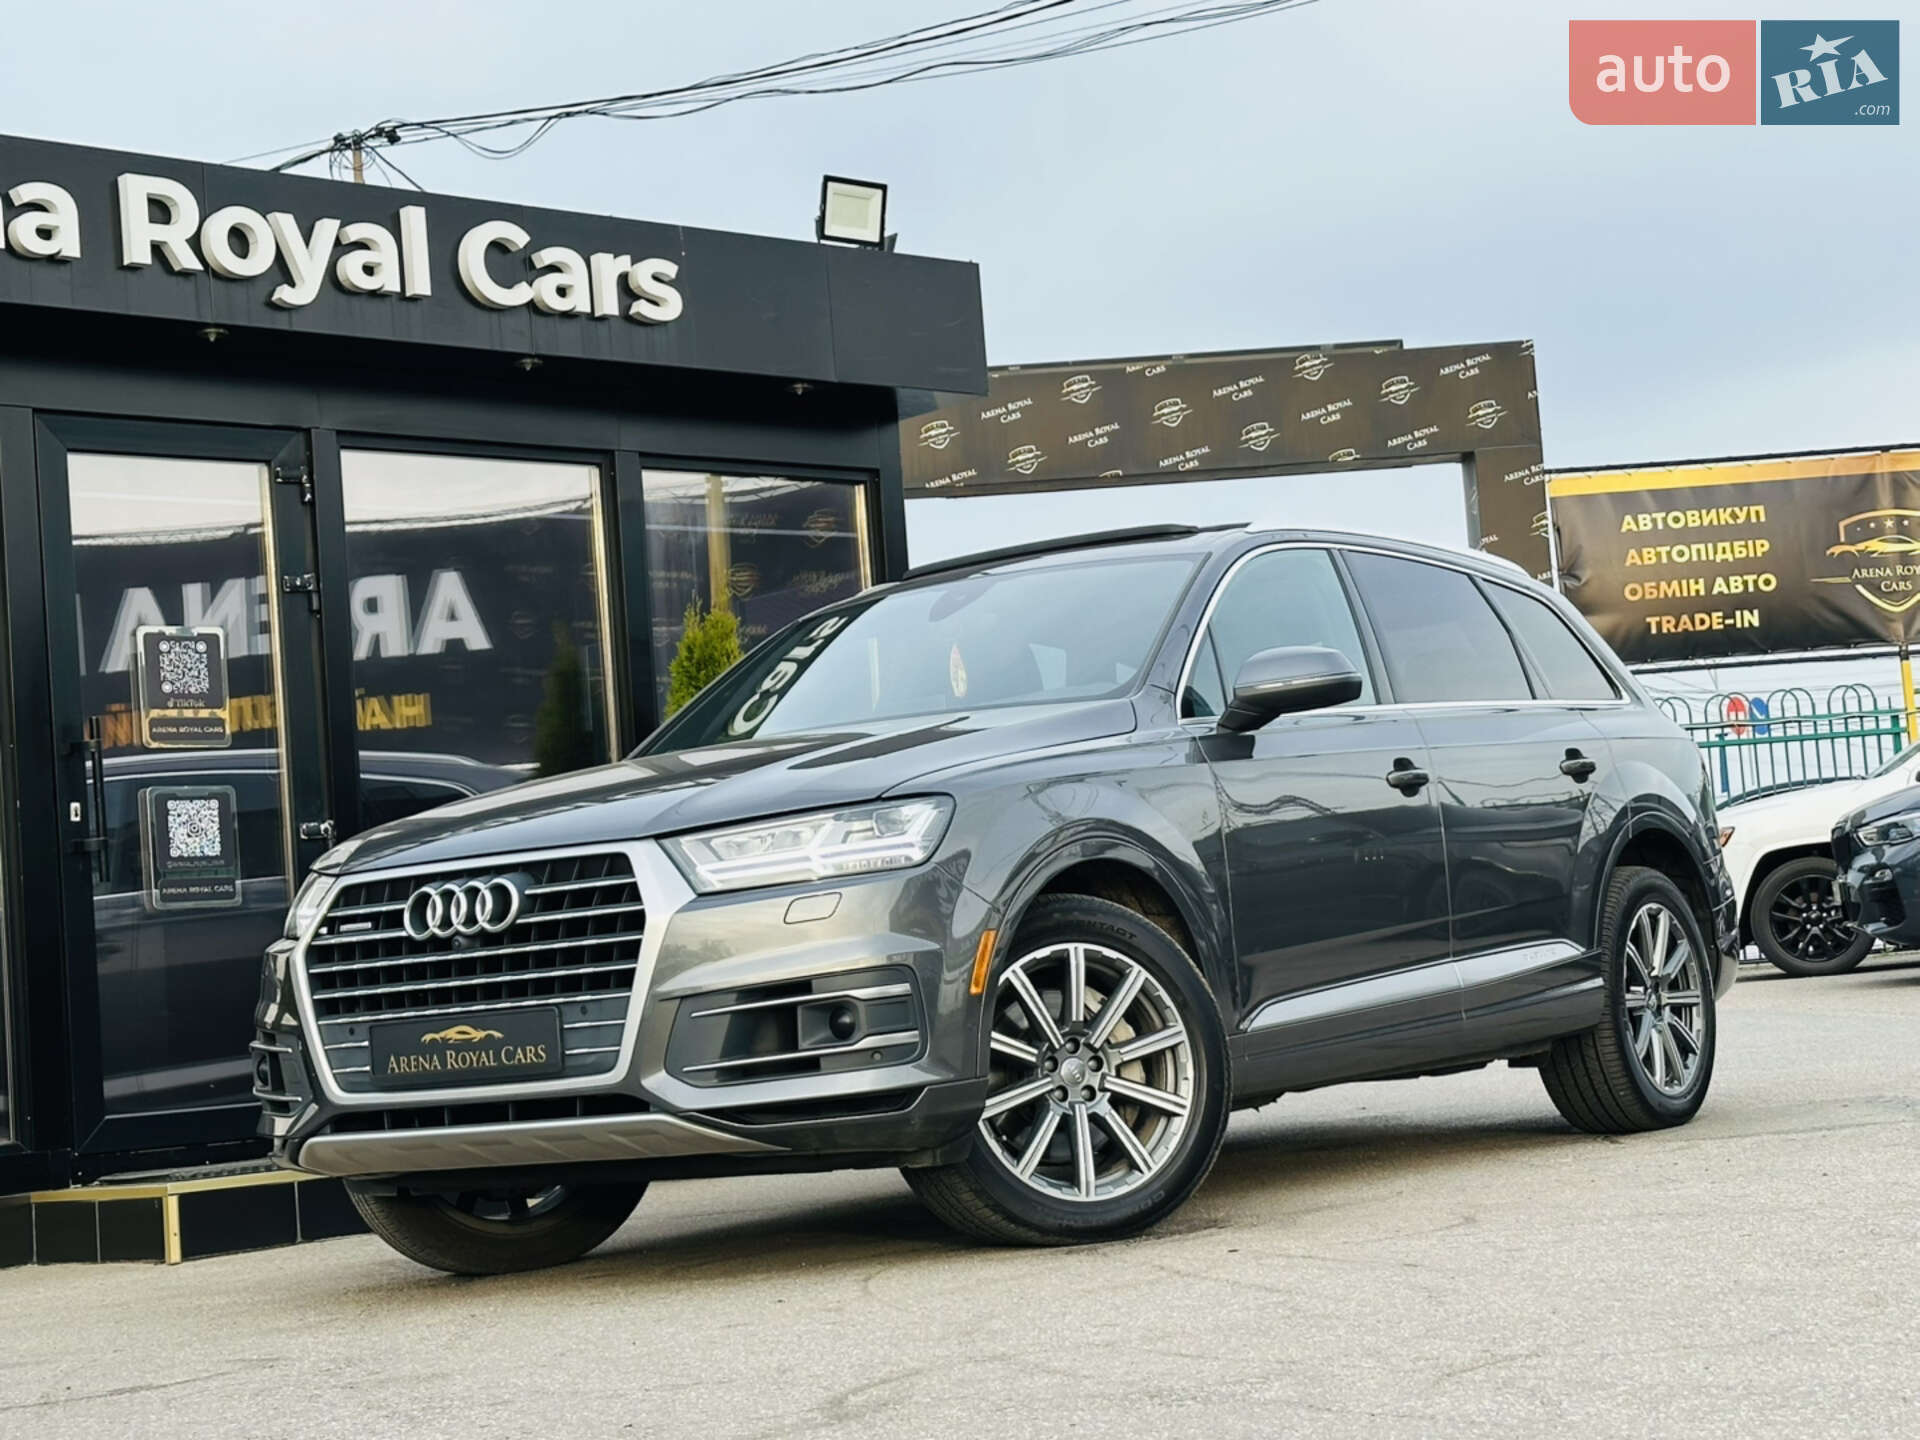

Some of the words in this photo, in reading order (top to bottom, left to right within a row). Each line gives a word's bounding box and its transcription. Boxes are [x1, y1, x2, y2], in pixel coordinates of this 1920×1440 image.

[117, 173, 431, 308] Royal
[457, 220, 682, 324] Cars
[1620, 505, 1766, 533] АВТОВИКУП
[1625, 539, 1770, 567] АВТОПІДБІР
[1623, 578, 1705, 601] ОБМІН
[1712, 573, 1777, 595] АВТО
[1852, 567, 1893, 579] ARENA
[1881, 580, 1912, 592] CARS
[1646, 609, 1759, 634] TRADE-IN
[387, 1054, 440, 1075] ARENA
[446, 1049, 497, 1069] ROYAL
[501, 1043, 547, 1065] CARS
